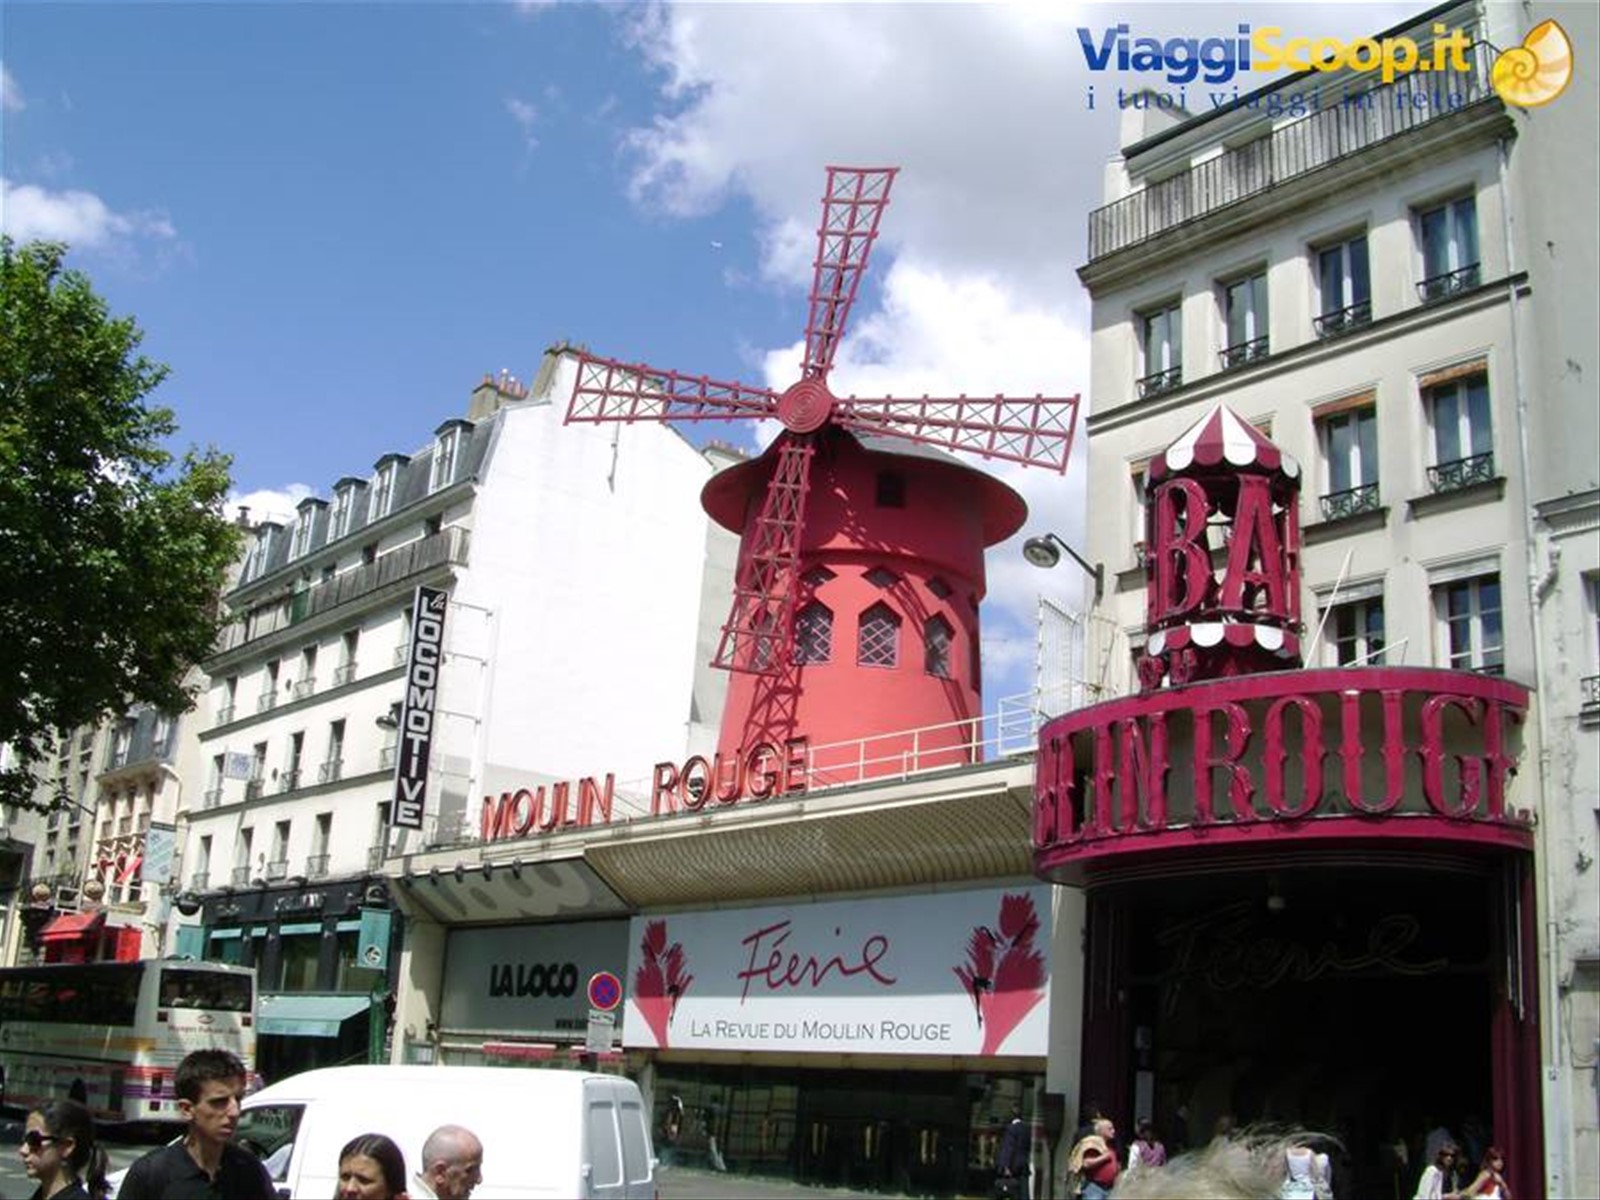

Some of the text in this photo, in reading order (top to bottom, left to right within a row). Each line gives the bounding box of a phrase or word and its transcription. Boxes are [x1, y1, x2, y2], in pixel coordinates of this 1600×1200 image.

[1154, 473, 1299, 622] BA
[396, 596, 442, 826] LOCOMOTIVE
[481, 734, 811, 842] MOULIN ROUGE
[489, 962, 579, 998] LA LOCO
[802, 1020, 875, 1040] MOULIN
[880, 1020, 952, 1041] ROUGE
